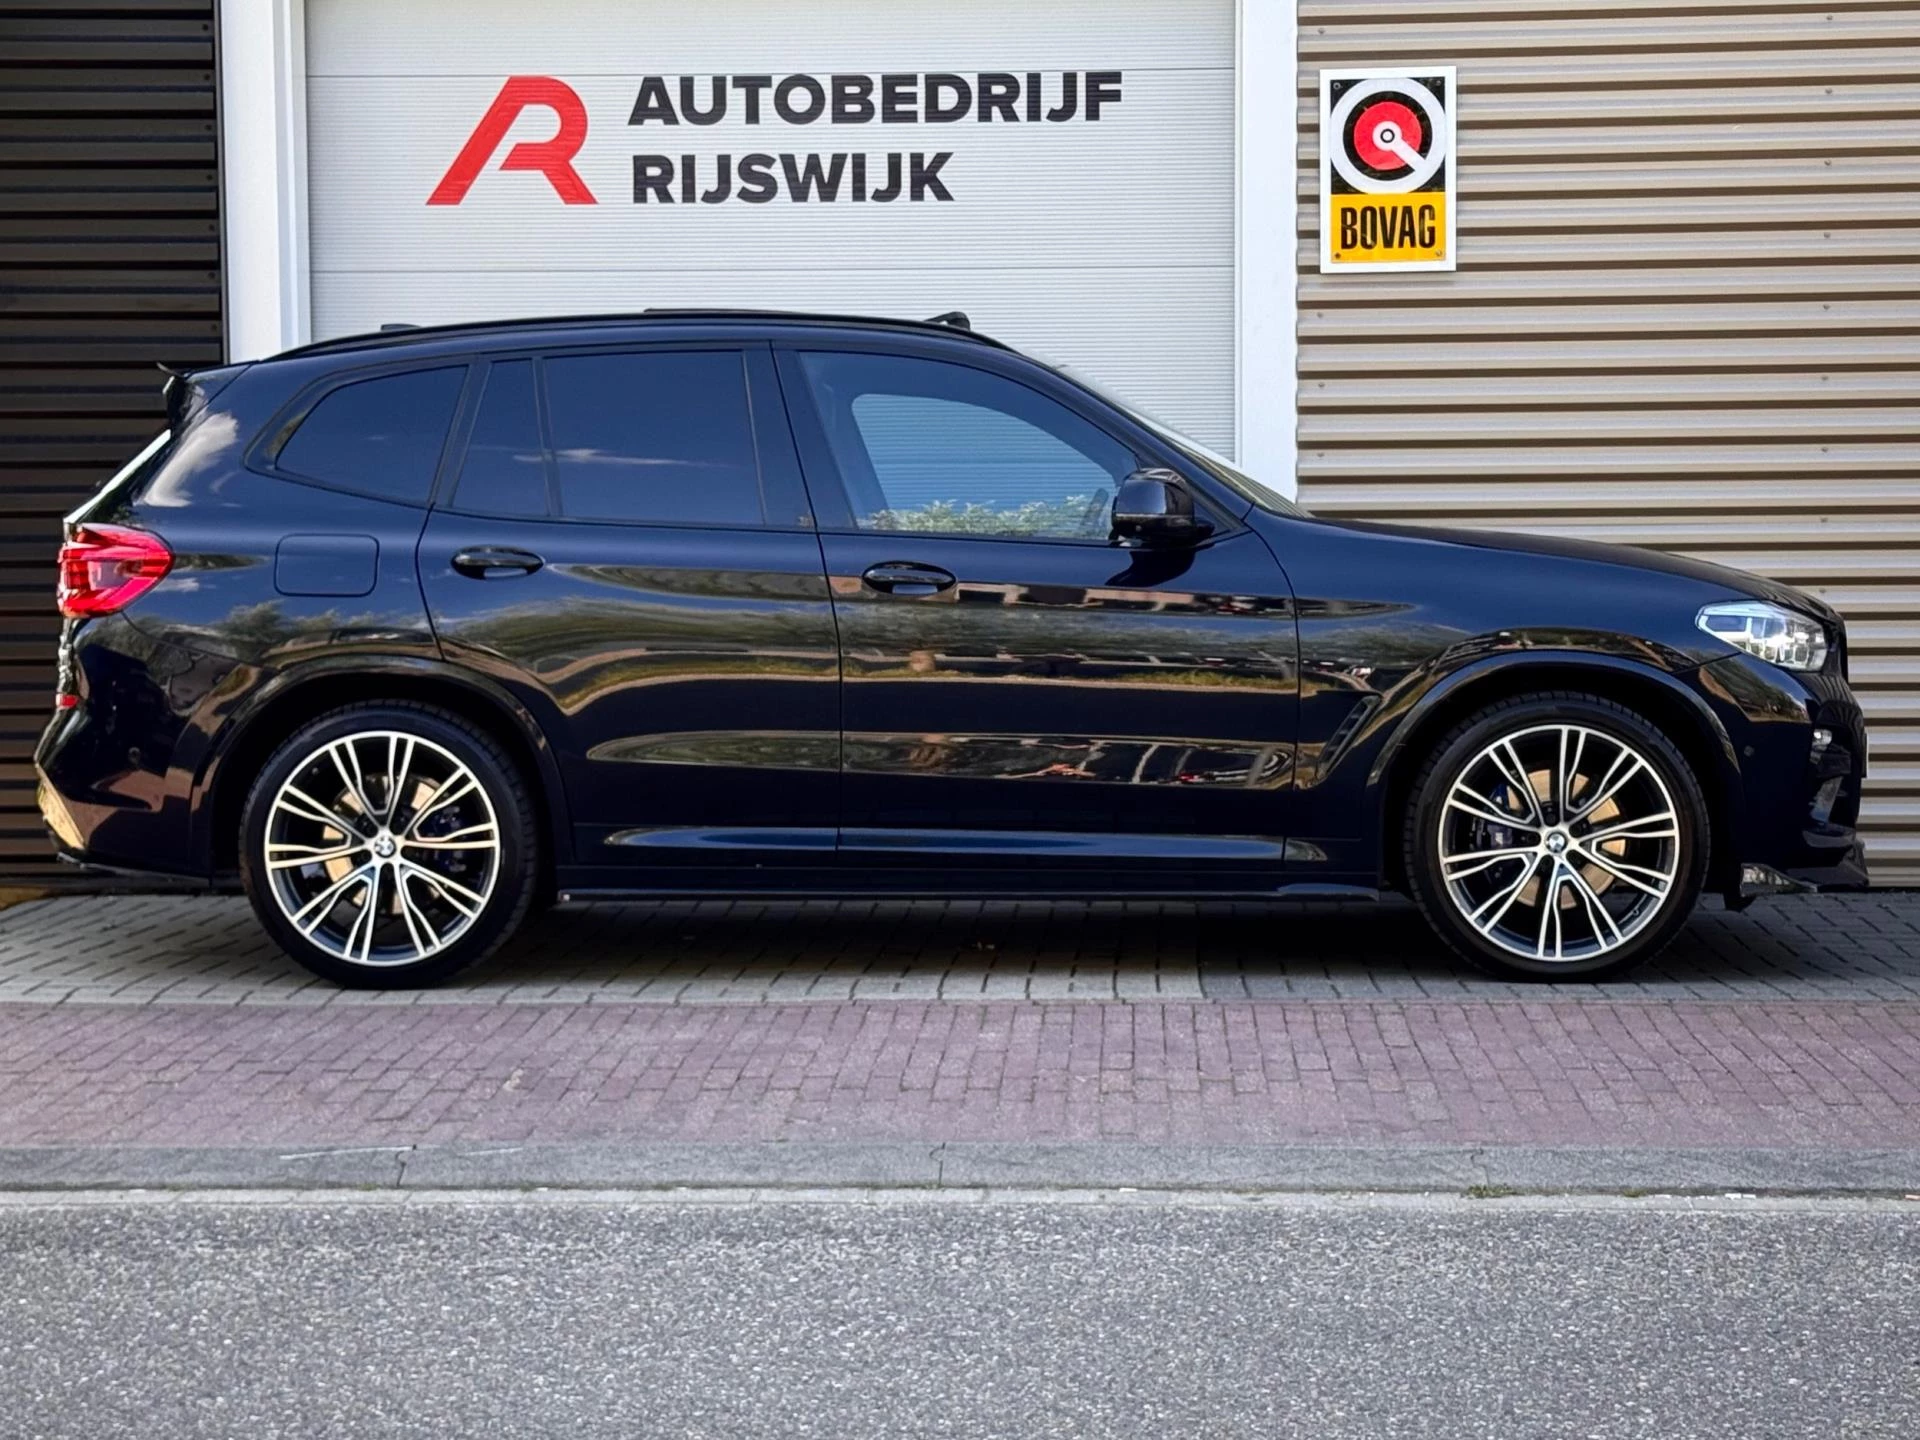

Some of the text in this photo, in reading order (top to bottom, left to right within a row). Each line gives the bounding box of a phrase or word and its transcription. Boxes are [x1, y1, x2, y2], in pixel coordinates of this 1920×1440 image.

[628, 71, 1122, 126] AUTOBEDRIJF
[632, 152, 954, 204] RIJSWIJK
[1340, 204, 1436, 250] BOVAG
